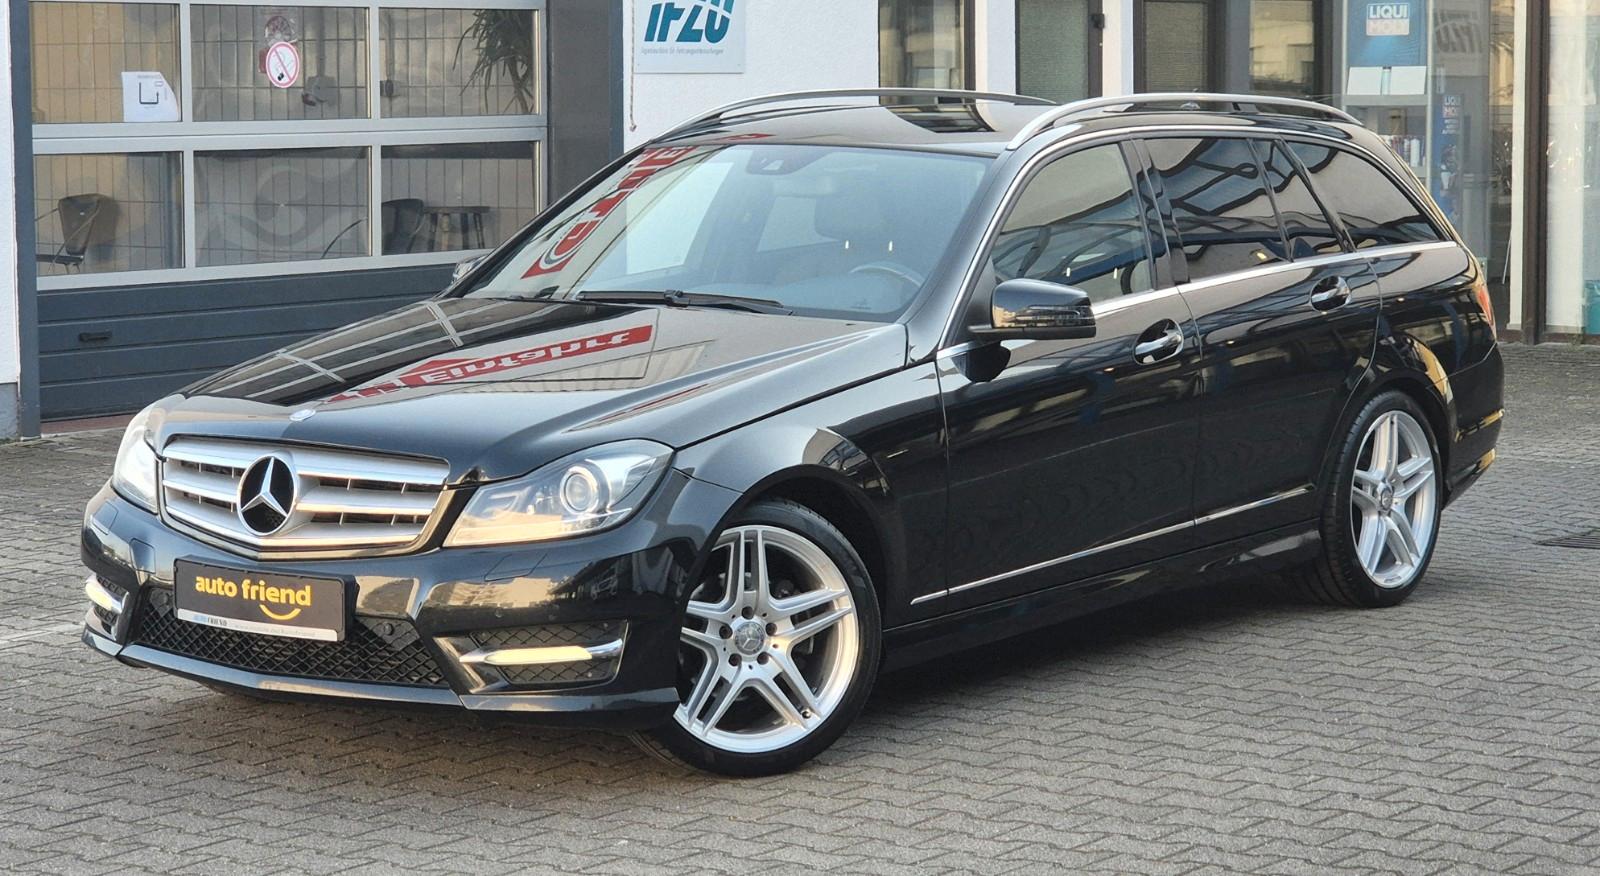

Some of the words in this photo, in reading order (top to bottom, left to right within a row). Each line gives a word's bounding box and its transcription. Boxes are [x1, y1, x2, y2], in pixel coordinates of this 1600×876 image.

[1369, 5, 1408, 18] LIQUI
[195, 576, 238, 598] auto
[241, 579, 312, 606] friend
